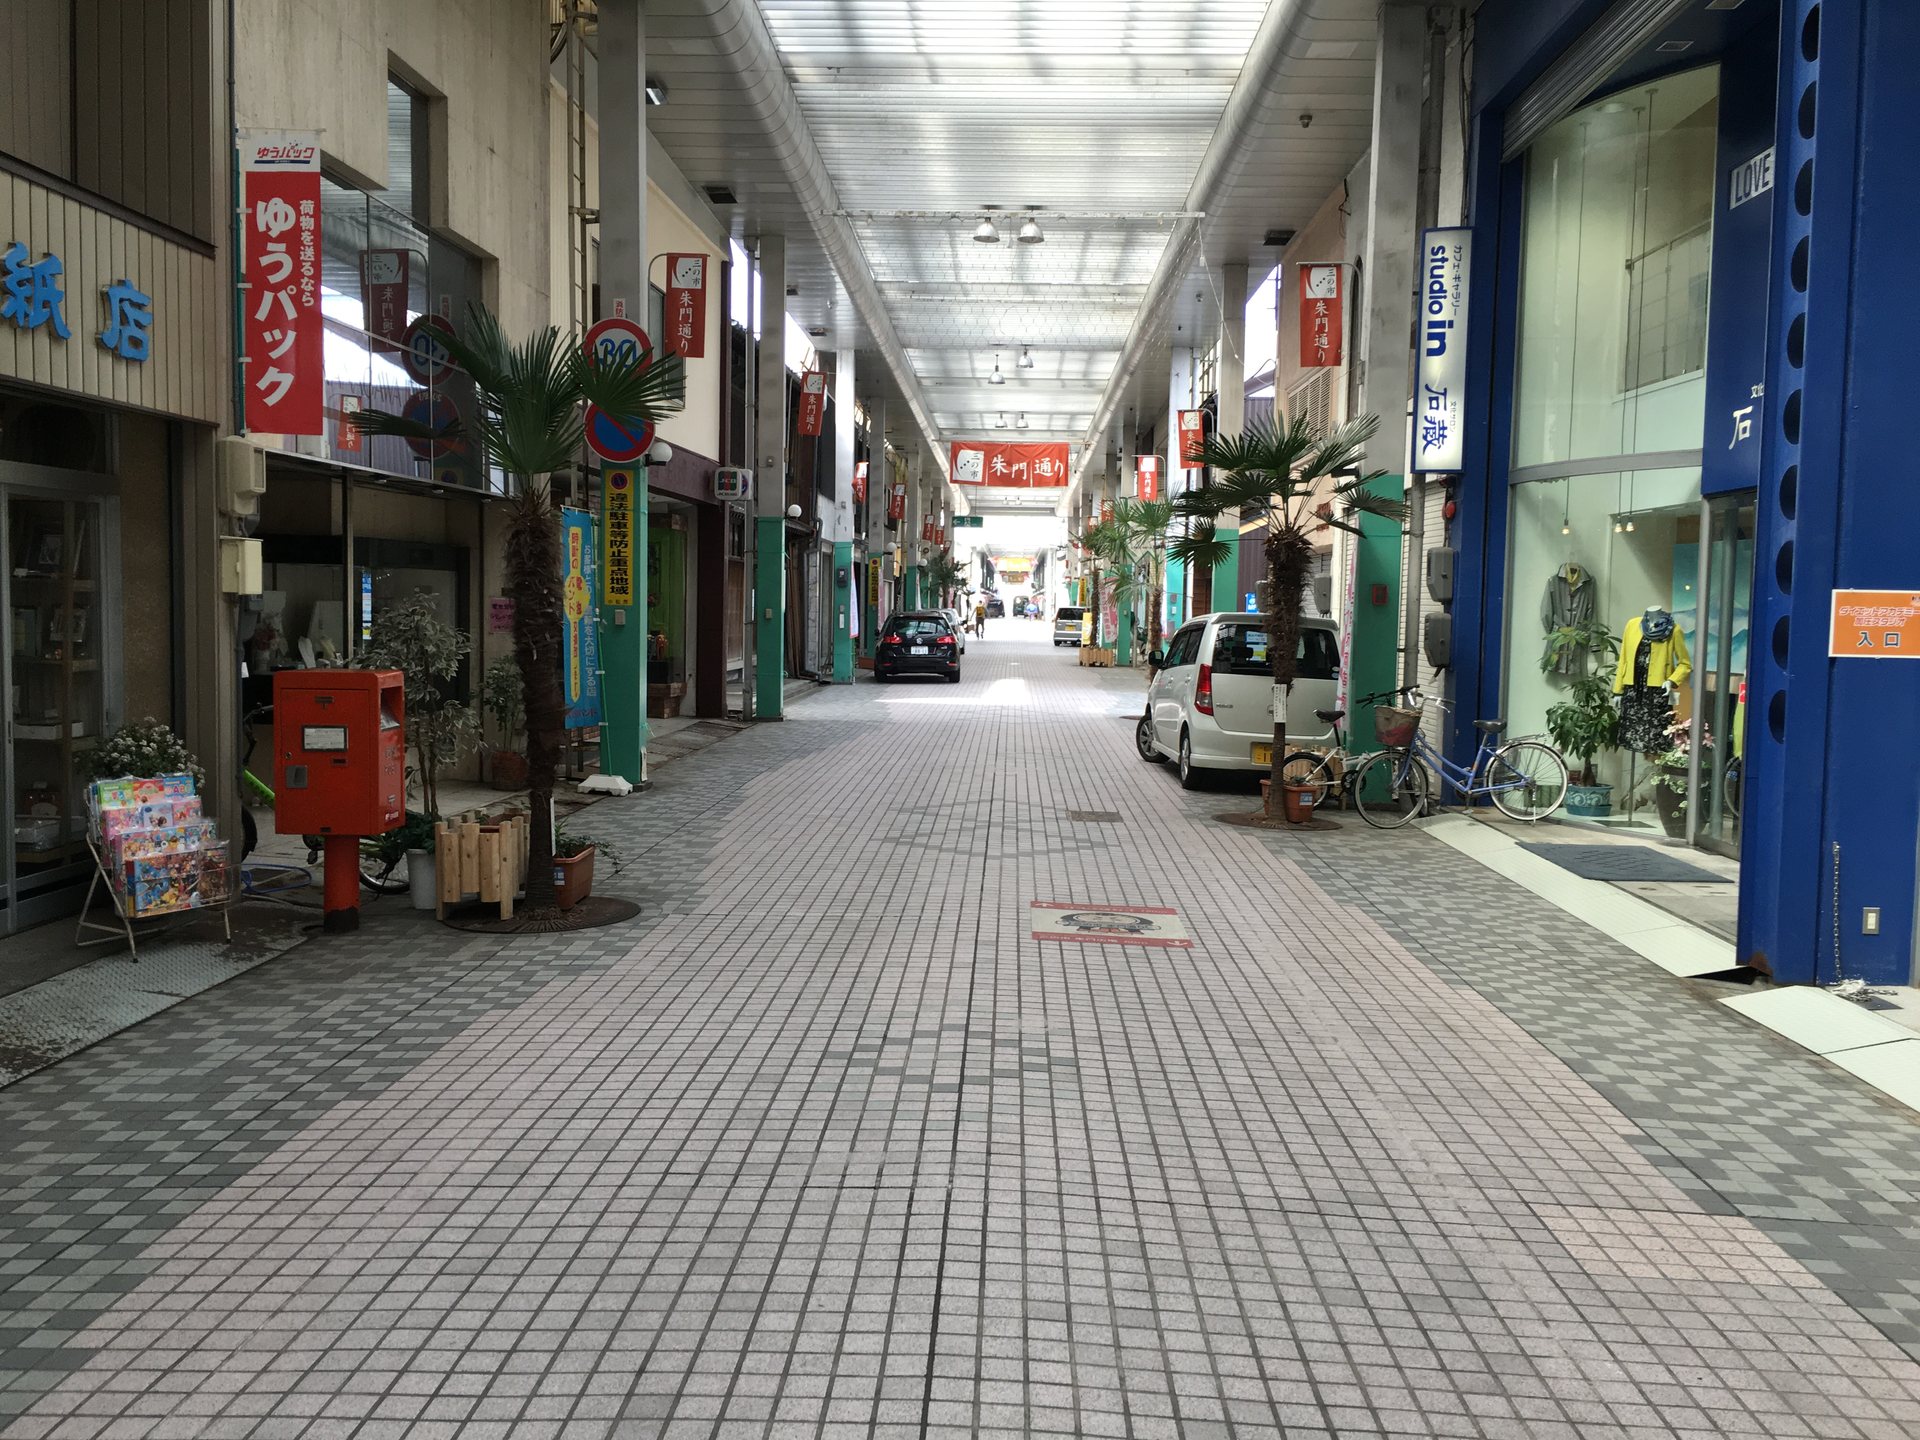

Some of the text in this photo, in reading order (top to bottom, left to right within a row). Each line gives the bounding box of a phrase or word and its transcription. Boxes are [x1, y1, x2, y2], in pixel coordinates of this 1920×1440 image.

[256, 145, 315, 158] ゆうパック
[1735, 152, 1770, 203] LOVE
[300, 200, 315, 307] 荷物を送るなら
[692, 260, 702, 286] 三の市
[255, 197, 296, 407] ゆうパック
[1326, 268, 1336, 296] 三の市
[1426, 245, 1454, 357] studio in
[678, 290, 693, 353] 朱門通り
[1314, 300, 1330, 364] 朱門通り
[1728, 406, 1753, 450] 石
[971, 453, 980, 480] 三の市
[990, 454, 1064, 481] 朱門通り
[609, 493, 629, 595] 違法駐車等防止重点地域
[1857, 631, 1900, 648] 入口
